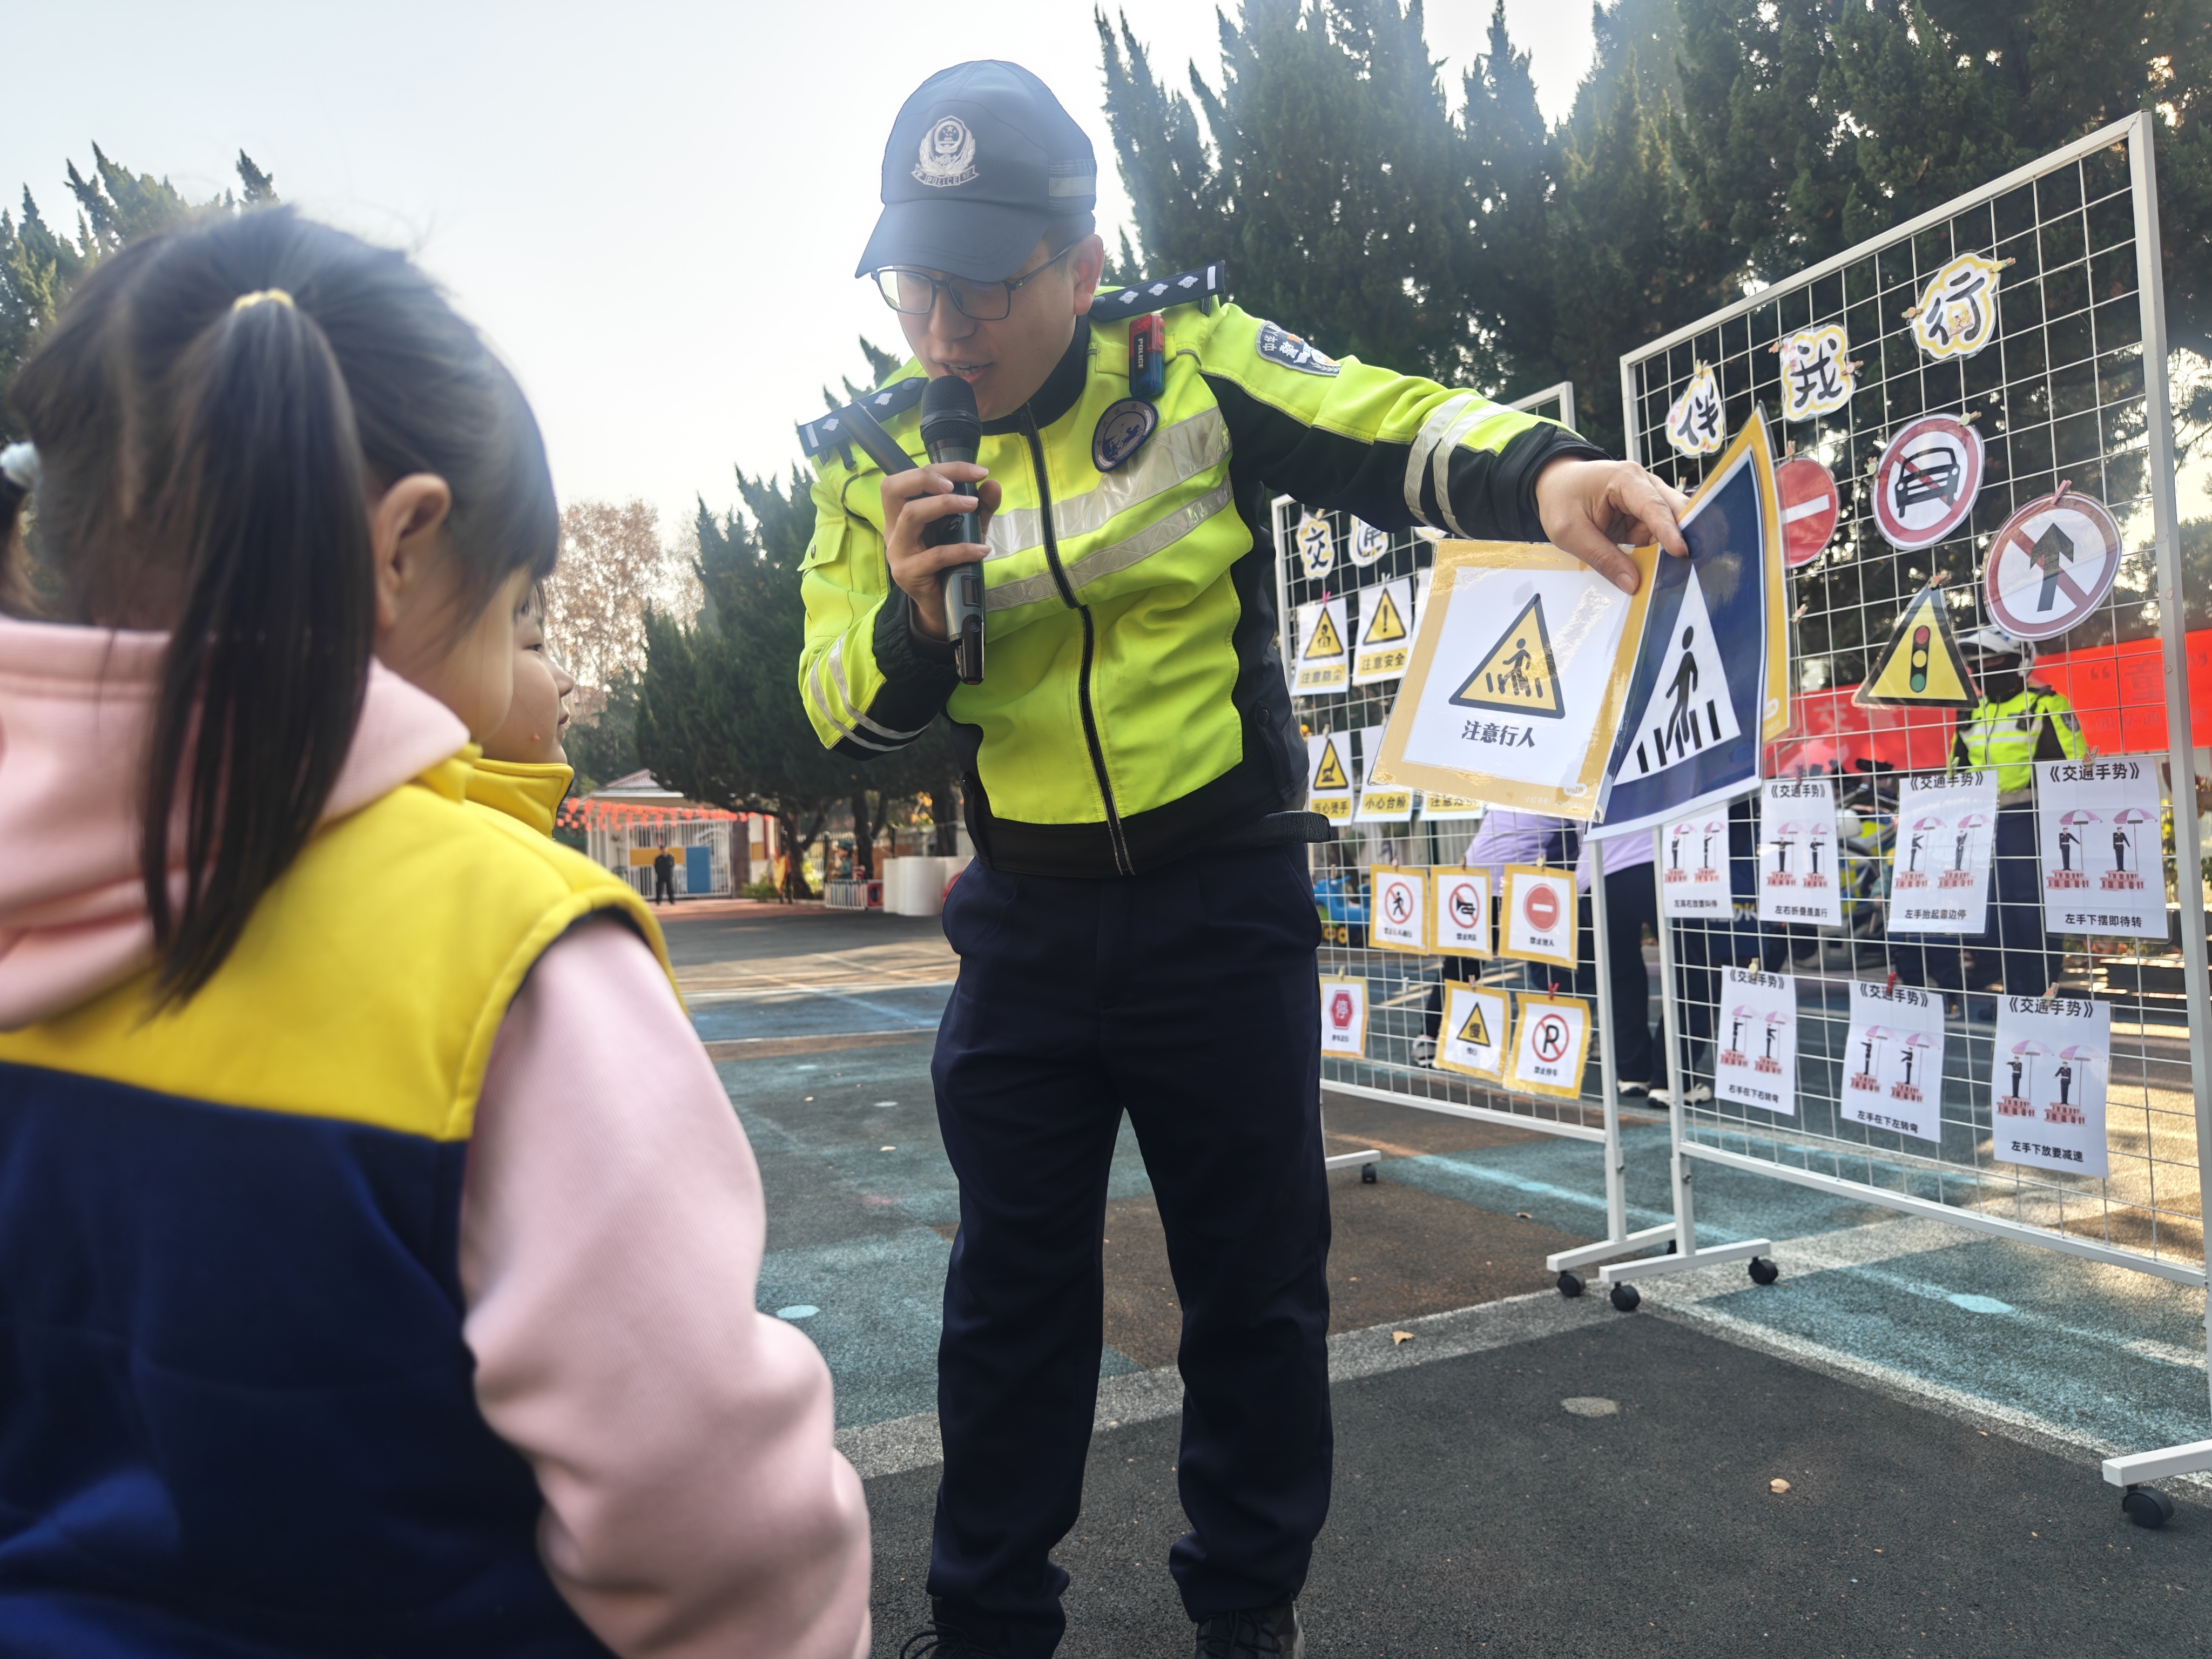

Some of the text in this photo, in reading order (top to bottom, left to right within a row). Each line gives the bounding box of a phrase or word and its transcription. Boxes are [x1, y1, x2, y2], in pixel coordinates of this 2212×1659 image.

[927, 176, 958, 185] POLICE
[1677, 272, 1985, 447] 伴 我 行
[1305, 527, 1328, 570] 交
[1361, 653, 1404, 671] 注意安全
[1461, 720, 1535, 748] 注意行人
[1911, 771, 1983, 791] 《交通手势》
[2050, 762, 2139, 782] 《交通手势》
[1771, 785, 1825, 798] 《交通手势》
[1365, 795, 1406, 810] 小心台阶
[2065, 914, 2142, 928] 左手下摆即待转
[1336, 1000, 1348, 1019] 停
[2009, 997, 2093, 1018] 《交通手势》
[2011, 1141, 2083, 1162] 左手下放要减速
